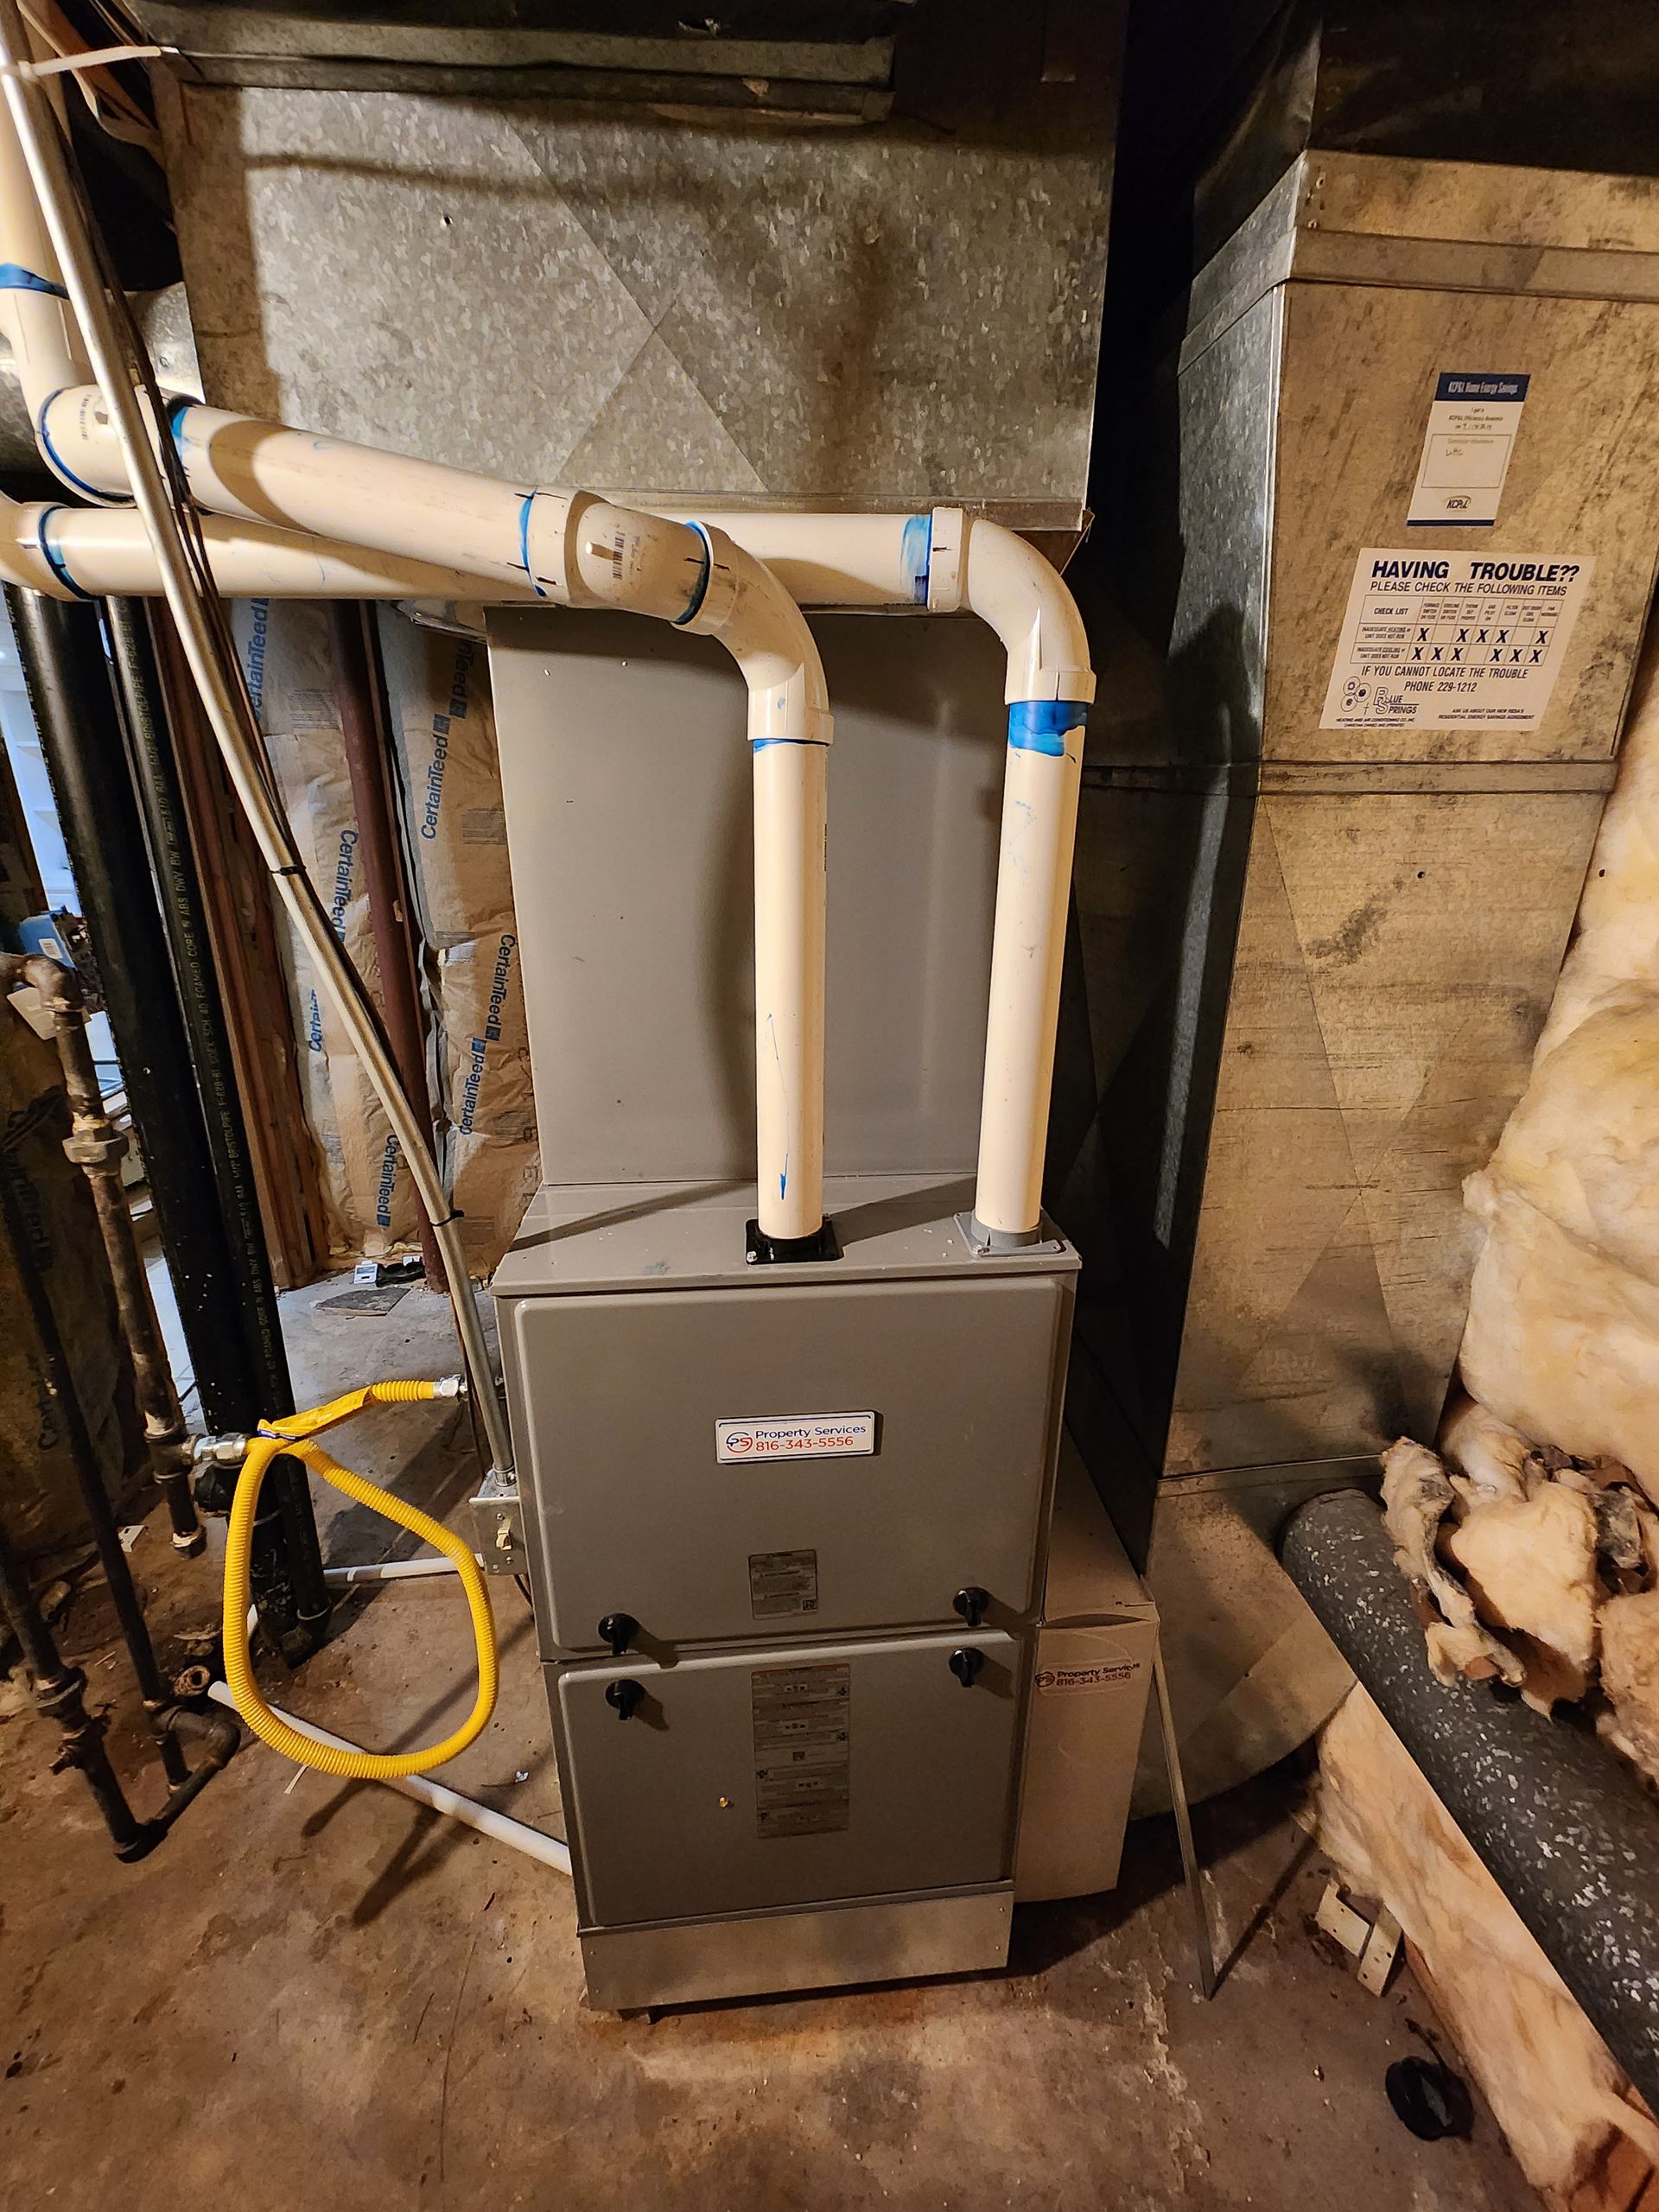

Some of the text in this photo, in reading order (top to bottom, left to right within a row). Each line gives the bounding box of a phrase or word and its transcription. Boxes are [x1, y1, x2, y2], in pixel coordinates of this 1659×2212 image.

[1480, 382, 1497, 395] Energy
[1371, 561, 1580, 582] HAVING TROUBLE??
[1370, 582, 1567, 596] PLEASE CHECK THE FOLLOWING ITEMS
[1417, 628, 1429, 641] X
[1456, 628, 1469, 642] X
[1476, 629, 1489, 642] X
[1496, 630, 1510, 643] X
[1535, 631, 1548, 644] X
[1411, 647, 1424, 660] X
[1431, 647, 1444, 660] X
[1450, 647, 1464, 661] X
[1490, 649, 1503, 662] X
[1510, 649, 1522, 662] X
[1529, 650, 1542, 663] X
[1361, 666, 1529, 678] IF YOU CANNOT LOCATE THE TROUBLE
[1404, 681, 1477, 692] PHONE 229-1212
[1373, 687, 1403, 704] BLUE
[1376, 698, 1417, 715] SPRINGS
[421, 734, 448, 840] CertainTeed
[172, 869, 187, 893] DWV
[332, 830, 359, 931] CertainTeed
[176, 895, 191, 917] ABS
[183, 931, 199, 957] CORE
[486, 934, 516, 1027] CertainTeed
[460, 1051, 486, 1136] CertainTeed
[377, 1134, 400, 1215] CertainTeed
[755, 1425, 867, 1440] Property Services
[755, 1436, 854, 1452] 816-343-5556
[1057, 1669, 1101, 1678] Property
